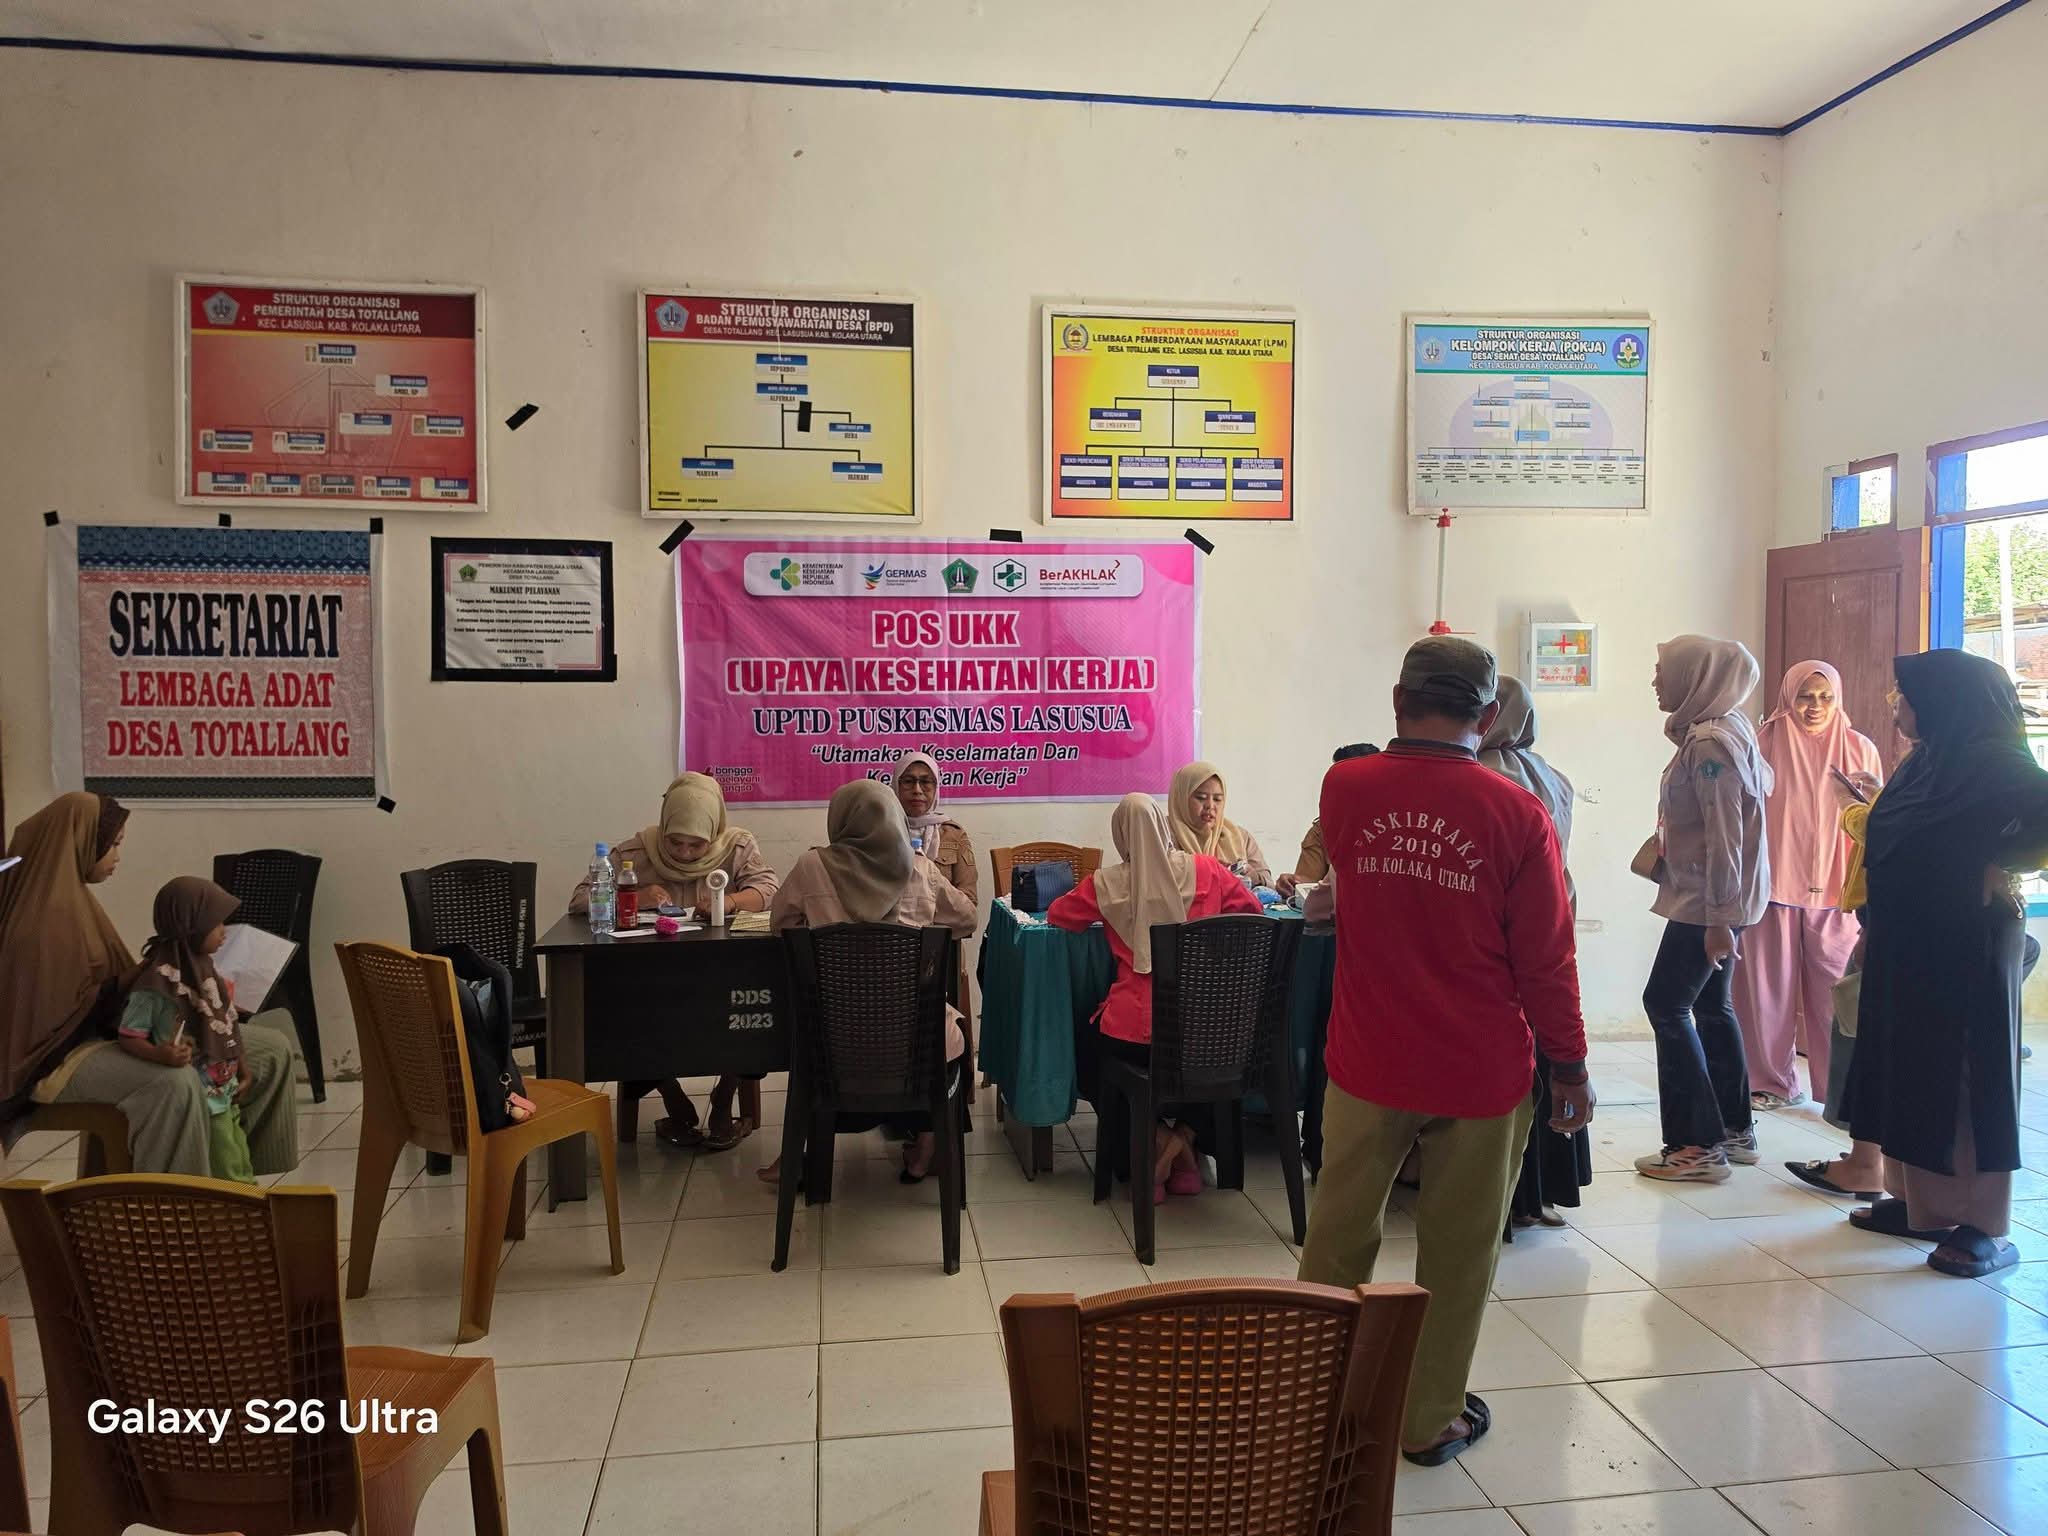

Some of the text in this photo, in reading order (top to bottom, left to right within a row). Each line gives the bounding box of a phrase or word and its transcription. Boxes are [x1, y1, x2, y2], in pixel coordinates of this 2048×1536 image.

[272, 293, 400, 308] STRUKTUR ORGANISASI
[254, 305, 420, 321] PEMERINTAH DESA TOTALLANG
[721, 303, 870, 321] STRUKTUR ORGANISASI
[257, 318, 422, 334] KEC. LASUSUA KAB. KOLAKA UTARA
[696, 314, 894, 334] BADAN PEMUSYAWARATAN DESA (BPD)
[723, 328, 762, 336] TOTALLANG
[832, 332, 860, 340] KOLAKA
[1142, 327, 1239, 338] STRUKTUR ORGANISASI
[1478, 331, 1580, 340] STRUKTUR ORGANISASI
[1093, 334, 1287, 348] LEMBAGA PEMBERDAYAAN MASYARAKAT (LPM)
[1452, 340, 1606, 354] KELOMPOK KERJA (POKJA)
[1126, 346, 1160, 354] TOTALLANG
[1494, 353, 1518, 361] SEHAT
[1542, 354, 1585, 362] TOTALLANG
[886, 570, 926, 578] GERMAS
[1040, 569, 1116, 580] BerAKHLAK
[490, 586, 560, 596] MAKLUMAT PELAYANAN
[109, 590, 342, 658] SEKRETARIAT
[873, 611, 1020, 648] POS UKK
[726, 657, 1157, 694] (UPAYA KESEHATAN KERJA)
[120, 671, 335, 708] LEMBAGA ADAT
[753, 704, 1132, 734] UPTD PUSKESMAS LASUSUA
[108, 720, 350, 758] DESA TOTALLANG
[921, 743, 1040, 762] Keselamatan
[1044, 743, 1079, 760] Dan
[716, 766, 752, 776] bangga
[970, 767, 1028, 788] Kerja”
[722, 784, 752, 793] angsa
[1392, 836, 1442, 858] 2019
[1357, 857, 1476, 892] KAB. KOLAKA UTARA
[728, 1014, 773, 1030] 2023
